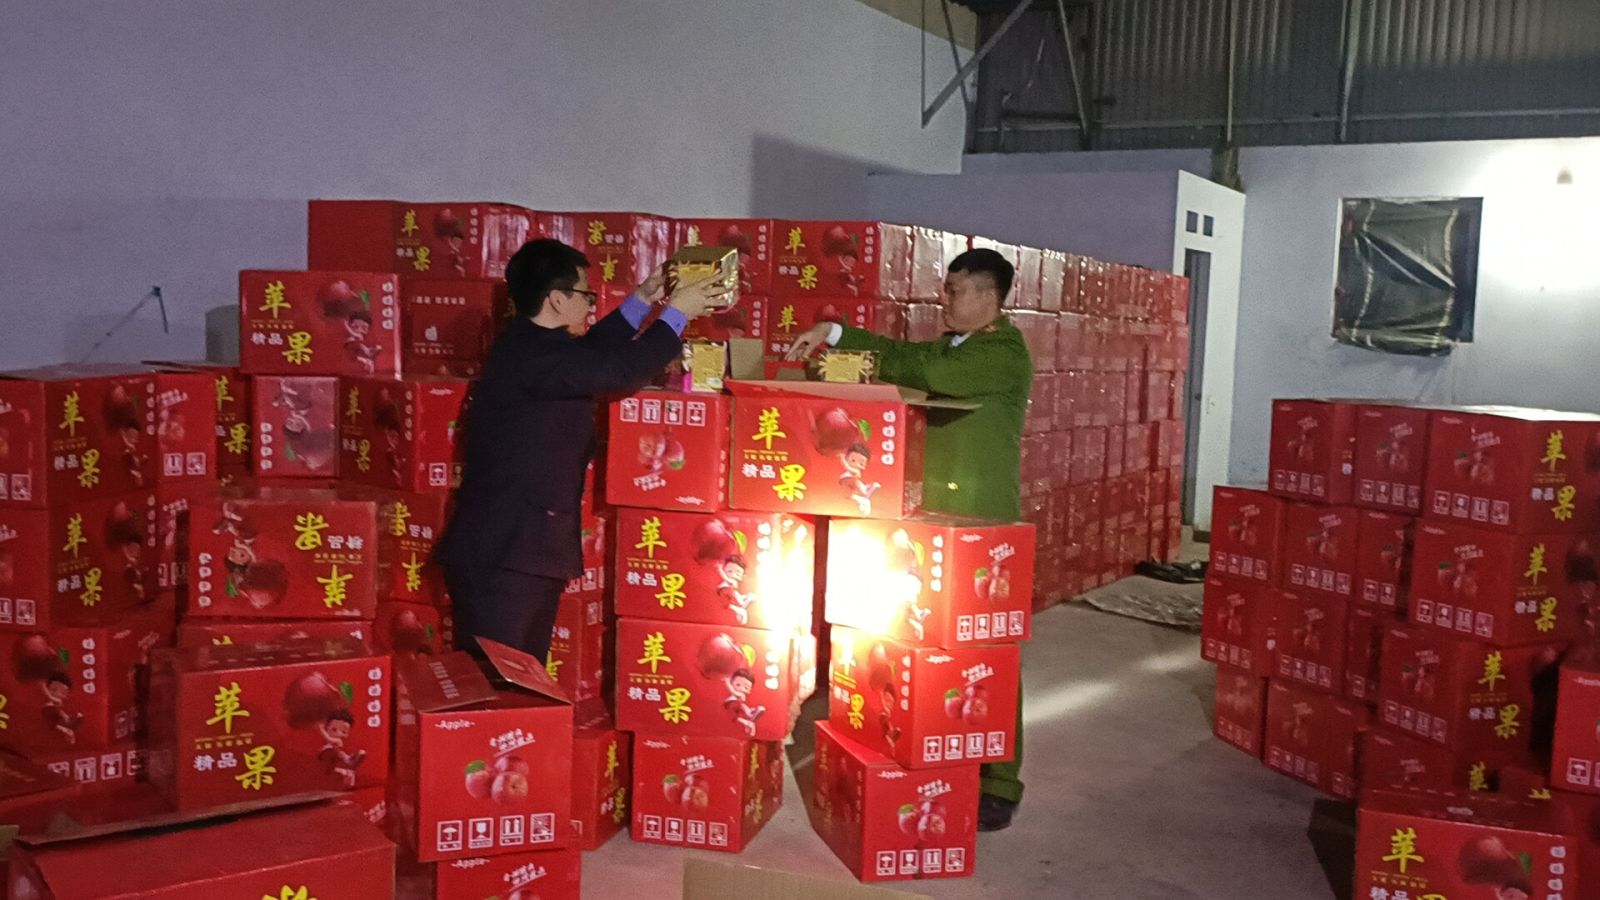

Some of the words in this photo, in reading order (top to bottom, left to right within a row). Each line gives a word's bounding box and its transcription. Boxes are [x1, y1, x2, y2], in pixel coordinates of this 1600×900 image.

[401, 209, 419, 237] 苹
[785, 227, 805, 255] 苹
[797, 265, 818, 290] 果
[259, 281, 291, 318] 苹
[777, 305, 797, 333] 苹
[282, 332, 312, 365] 果
[59, 391, 84, 436] 苹
[752, 407, 786, 450] 苹
[224, 423, 247, 454] 果
[1541, 430, 1566, 471] 苹
[77, 449, 100, 488] 果
[741, 463, 776, 479] 精品
[773, 463, 807, 503] 果
[1551, 485, 1576, 521] 果
[63, 513, 87, 558] 苹
[635, 517, 667, 558] 苹
[625, 571, 658, 587] 精品
[1524, 544, 1547, 584] 苹
[80, 568, 102, 606] 果
[655, 573, 686, 609] 果
[1535, 597, 1557, 632] 果
[638, 632, 671, 673] 苹
[1478, 651, 1505, 691] 苹
[206, 682, 250, 733] 苹
[627, 686, 662, 702] 精品
[659, 688, 692, 723] 果
[847, 694, 865, 730] 果
[1494, 704, 1520, 739] 果
[193, 751, 238, 772] 精品
[235, 746, 276, 790] 果
[1382, 827, 1424, 873] 苹
